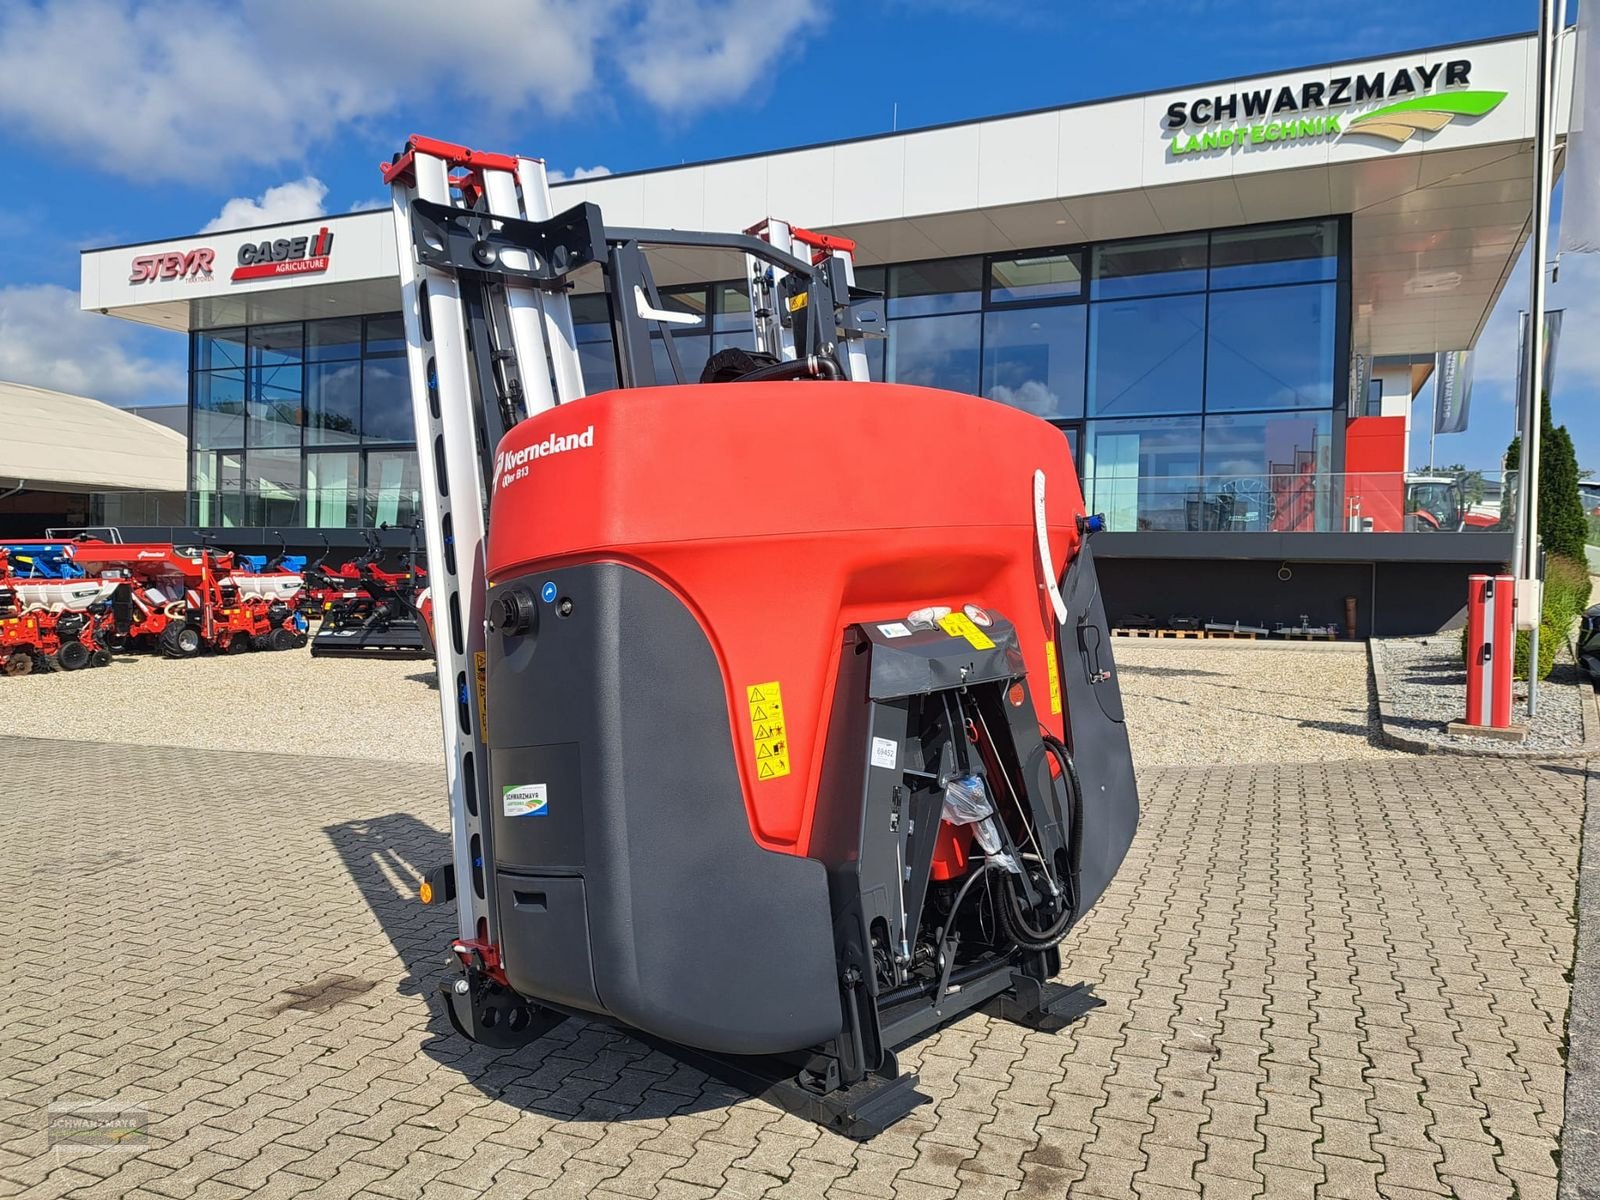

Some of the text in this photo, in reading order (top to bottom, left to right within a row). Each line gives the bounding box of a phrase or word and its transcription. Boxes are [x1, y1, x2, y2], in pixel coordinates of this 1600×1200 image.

[1167, 59, 1473, 129] SCHWARZMAYR
[1172, 114, 1342, 155] LANDTECHNIK
[129, 247, 216, 283] STEYR
[237, 236, 308, 267] CASE
[275, 259, 325, 273] AGRICULTURE
[504, 425, 594, 473] Kverneland
[516, 465, 529, 480] B13
